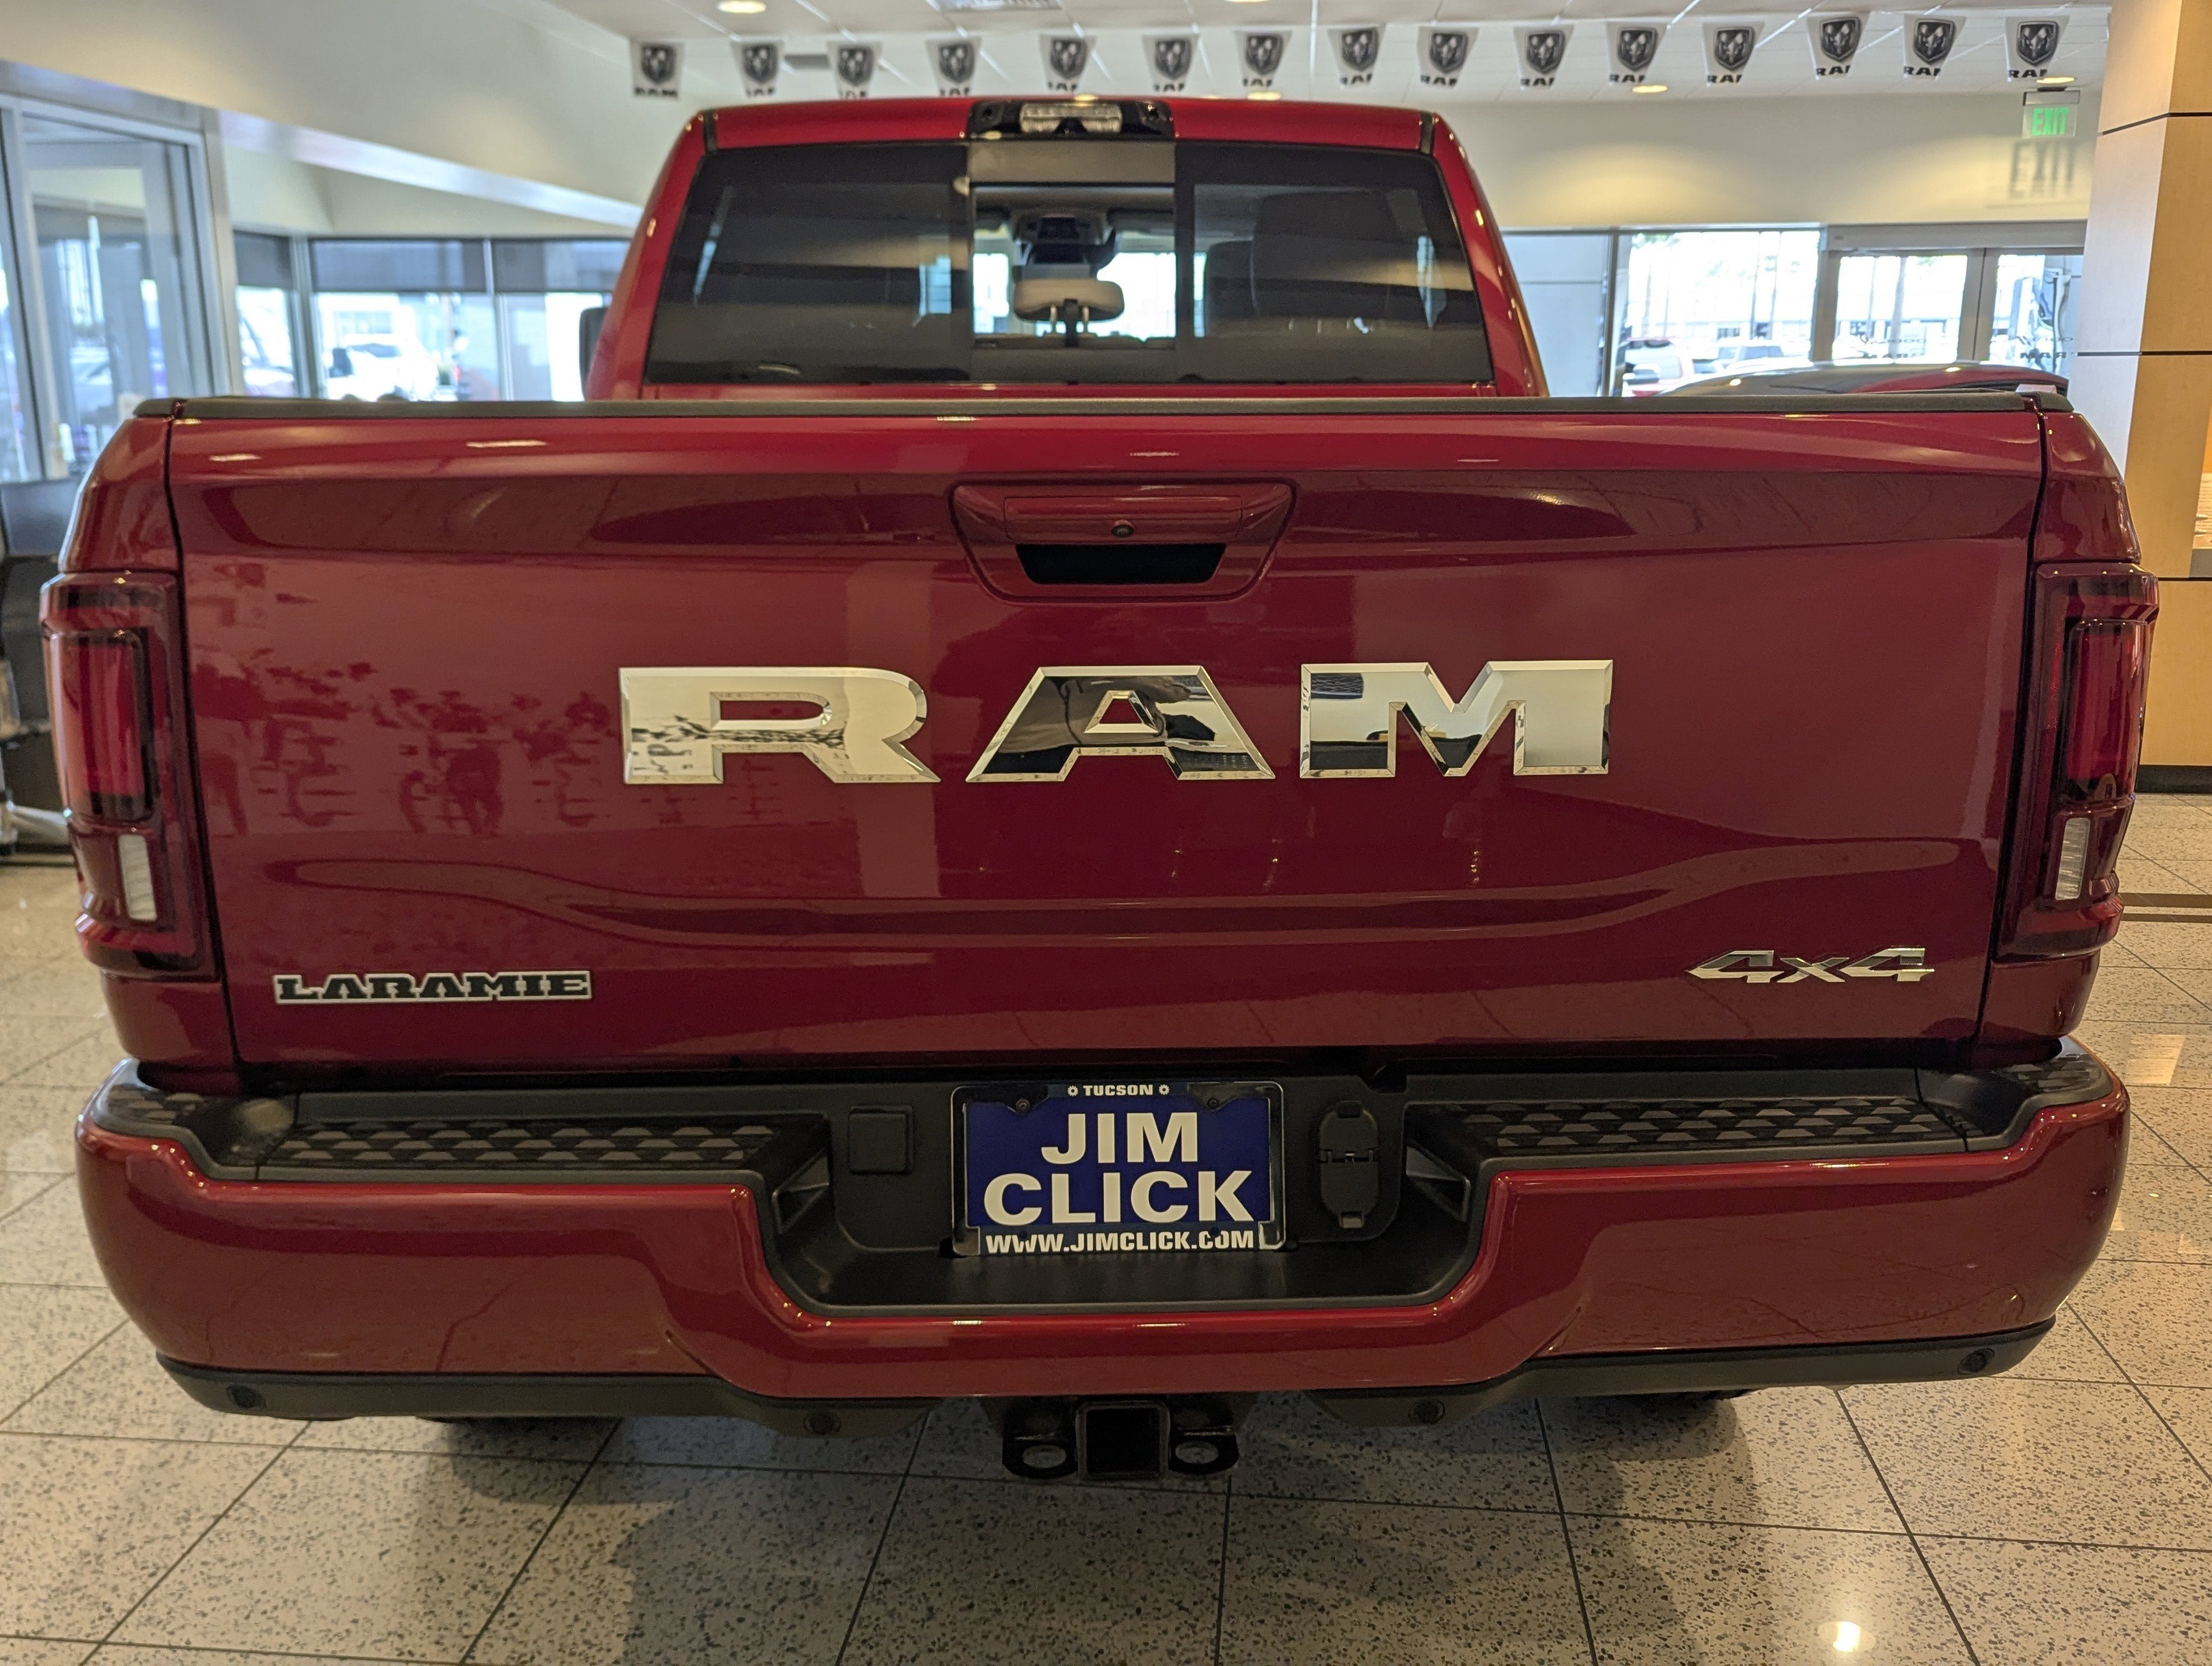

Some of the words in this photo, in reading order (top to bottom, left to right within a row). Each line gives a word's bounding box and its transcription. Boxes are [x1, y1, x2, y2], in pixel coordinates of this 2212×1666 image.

[2031, 107, 2069, 136] EXIT
[618, 659, 1613, 784] RAM
[273, 971, 591, 1004] LARAMIE
[1083, 1084, 1154, 1097] TUCSON
[1041, 1112, 1198, 1165] JIM
[983, 1170, 1254, 1226] CLICK
[986, 1230, 1255, 1254] WWW.JIMCLICK.COM
